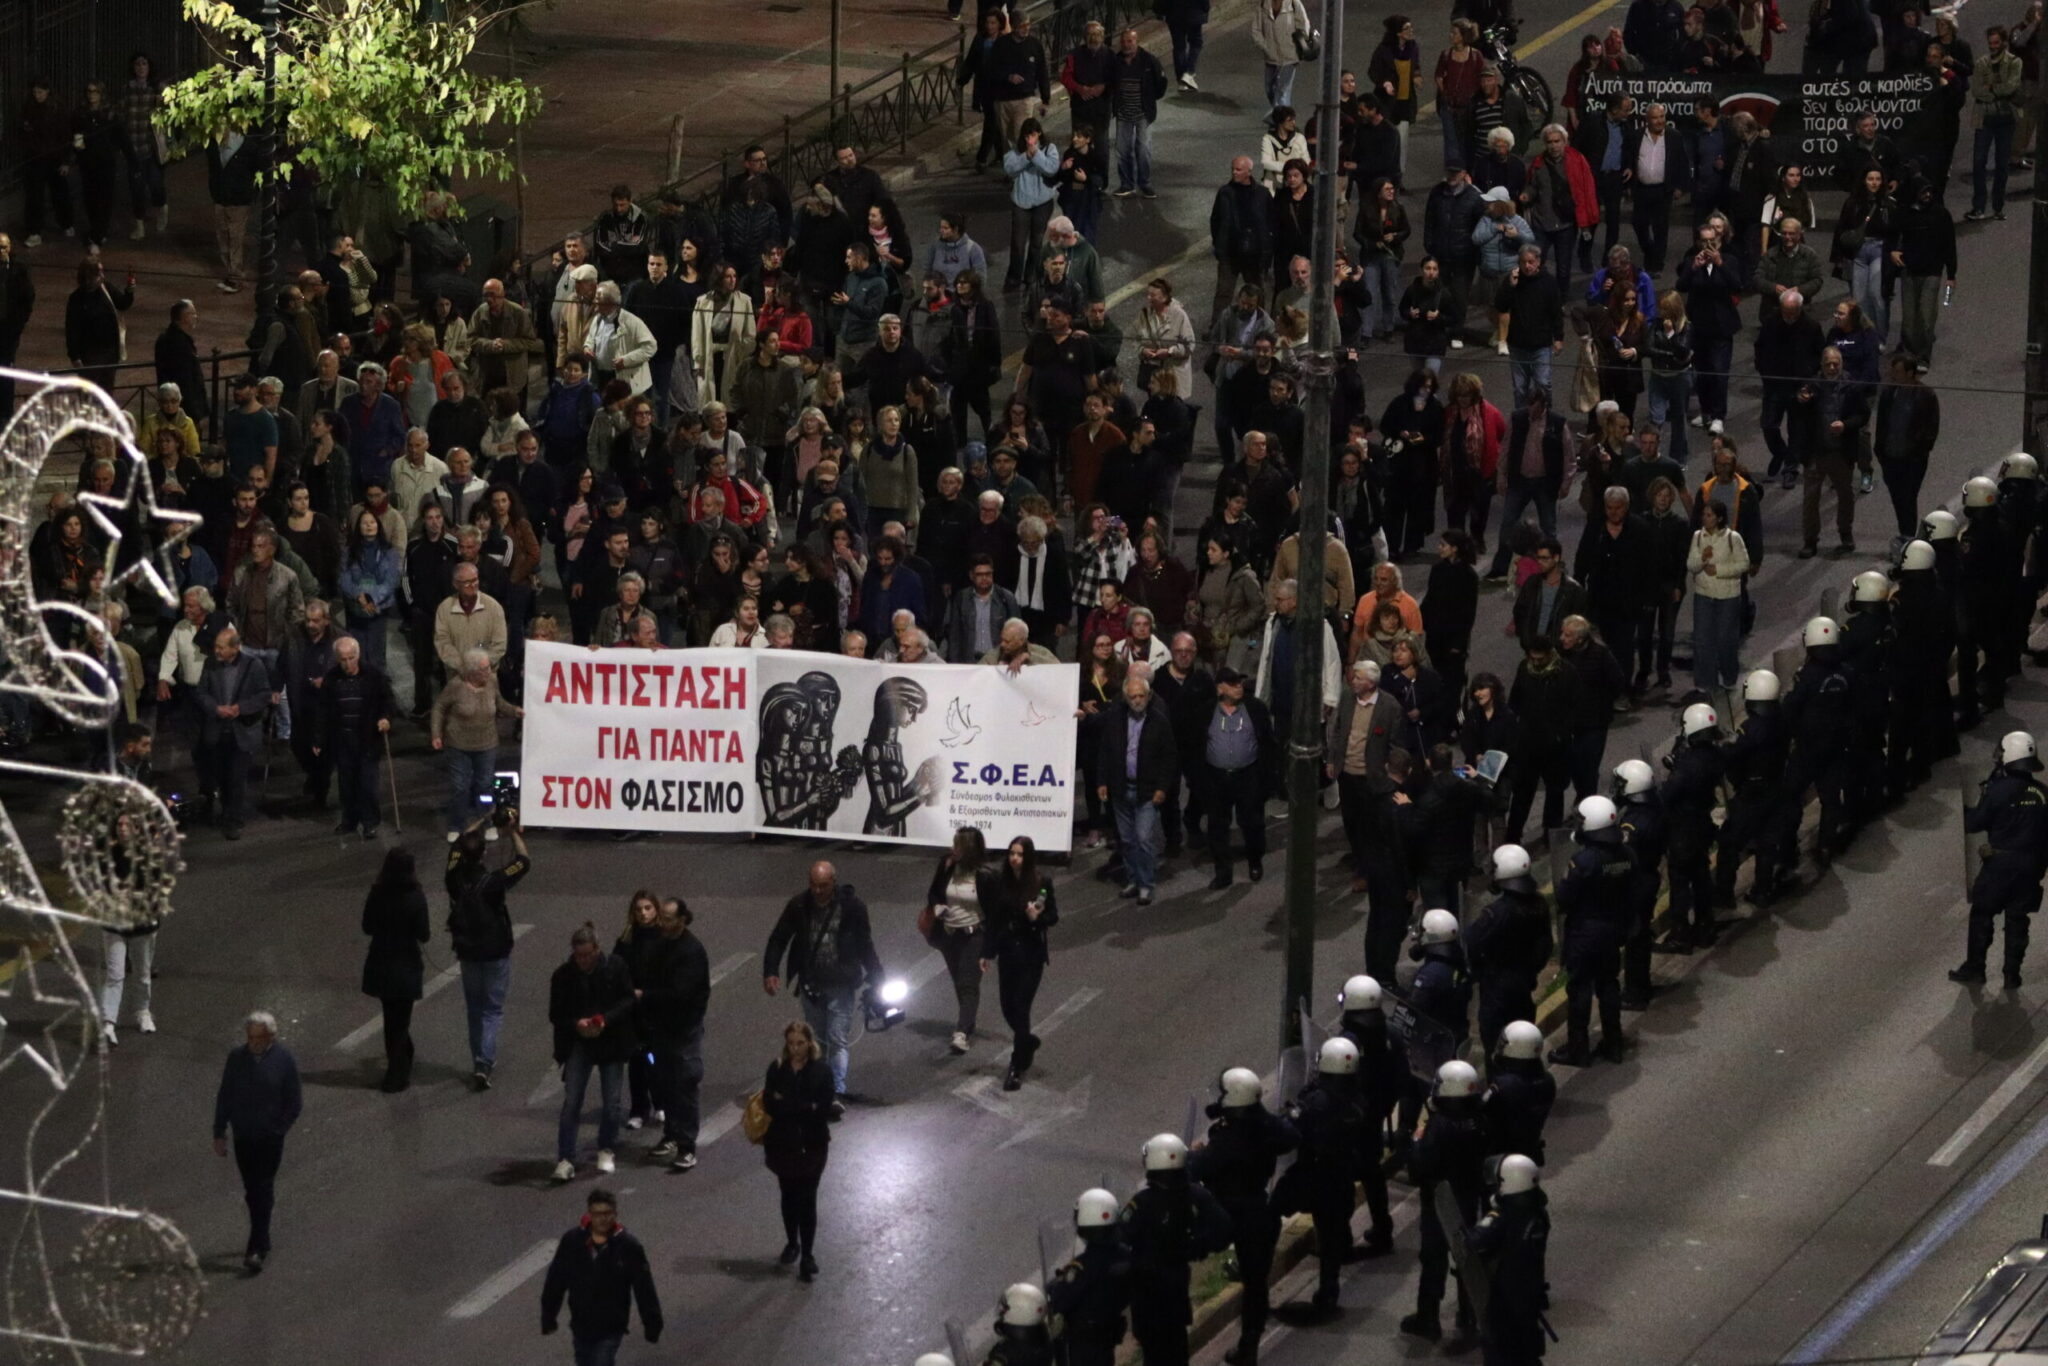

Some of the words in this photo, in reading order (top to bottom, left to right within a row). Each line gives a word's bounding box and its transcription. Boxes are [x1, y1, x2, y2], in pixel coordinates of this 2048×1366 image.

[1627, 80, 1643, 94] τα
[1647, 77, 1712, 99] πρόσωπα
[1802, 78, 1851, 96] αυτές
[1858, 80, 1872, 94] οι
[1877, 73, 1934, 97] καρδιές
[1802, 99, 1828, 115] δεν
[1802, 113, 1848, 135] παρά
[1873, 113, 1904, 130] όνο
[1802, 138, 1839, 154] στο
[544, 661, 747, 710] ΑΝΤΙΣΤΑΣΗ
[597, 726, 641, 760] ΓΙΑ
[650, 728, 744, 763] ΠΑΝΤΑ
[952, 761, 1065, 787] Σ.Φ.Ε.Α.
[541, 775, 612, 810] ΣΤΟΝ
[621, 778, 744, 814] ΦΑΣΙΣΜΟ
[949, 804, 956, 814] &
